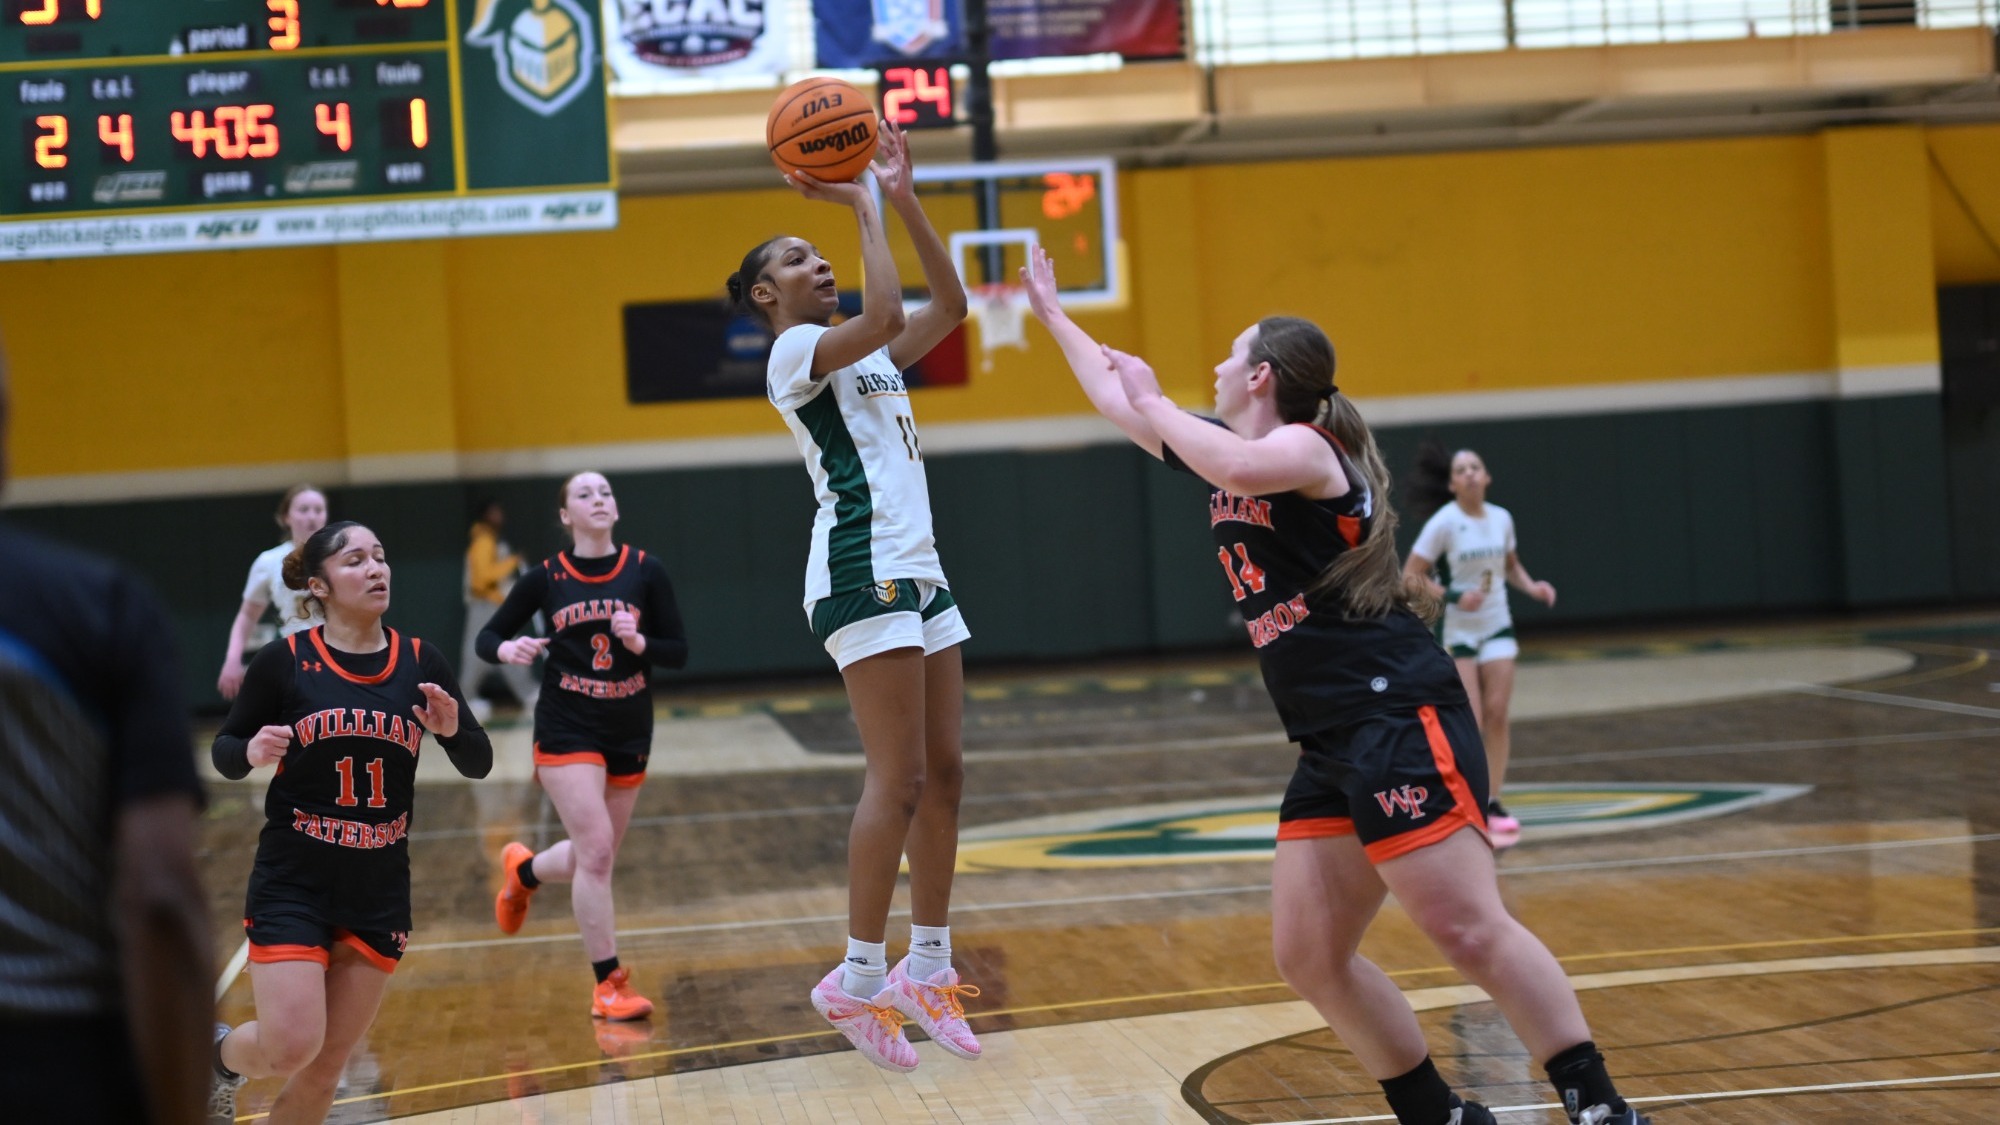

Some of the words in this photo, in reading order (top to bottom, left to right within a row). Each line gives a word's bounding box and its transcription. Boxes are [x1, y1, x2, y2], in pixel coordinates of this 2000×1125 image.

[188, 24, 248, 52] period
[267, 0, 300, 50] 3
[188, 71, 249, 96] player
[884, 68, 951, 123] 24
[35, 115, 68, 168] 2
[98, 114, 134, 162] 4
[315, 102, 352, 152] 4
[410, 98, 428, 149] 1
[799, 122, 871, 154] Wilson
[856, 373, 898, 396] JERSY
[896, 414, 923, 462] 11
[1218, 542, 1266, 602] 14
[552, 599, 641, 632] WILLIM
[591, 633, 612, 670] 2
[559, 671, 646, 698] PATERSON
[295, 708, 422, 758] WILLIAM
[335, 756, 387, 808] 11
[1374, 784, 1428, 819] WP
[292, 808, 408, 849] PATERSON
